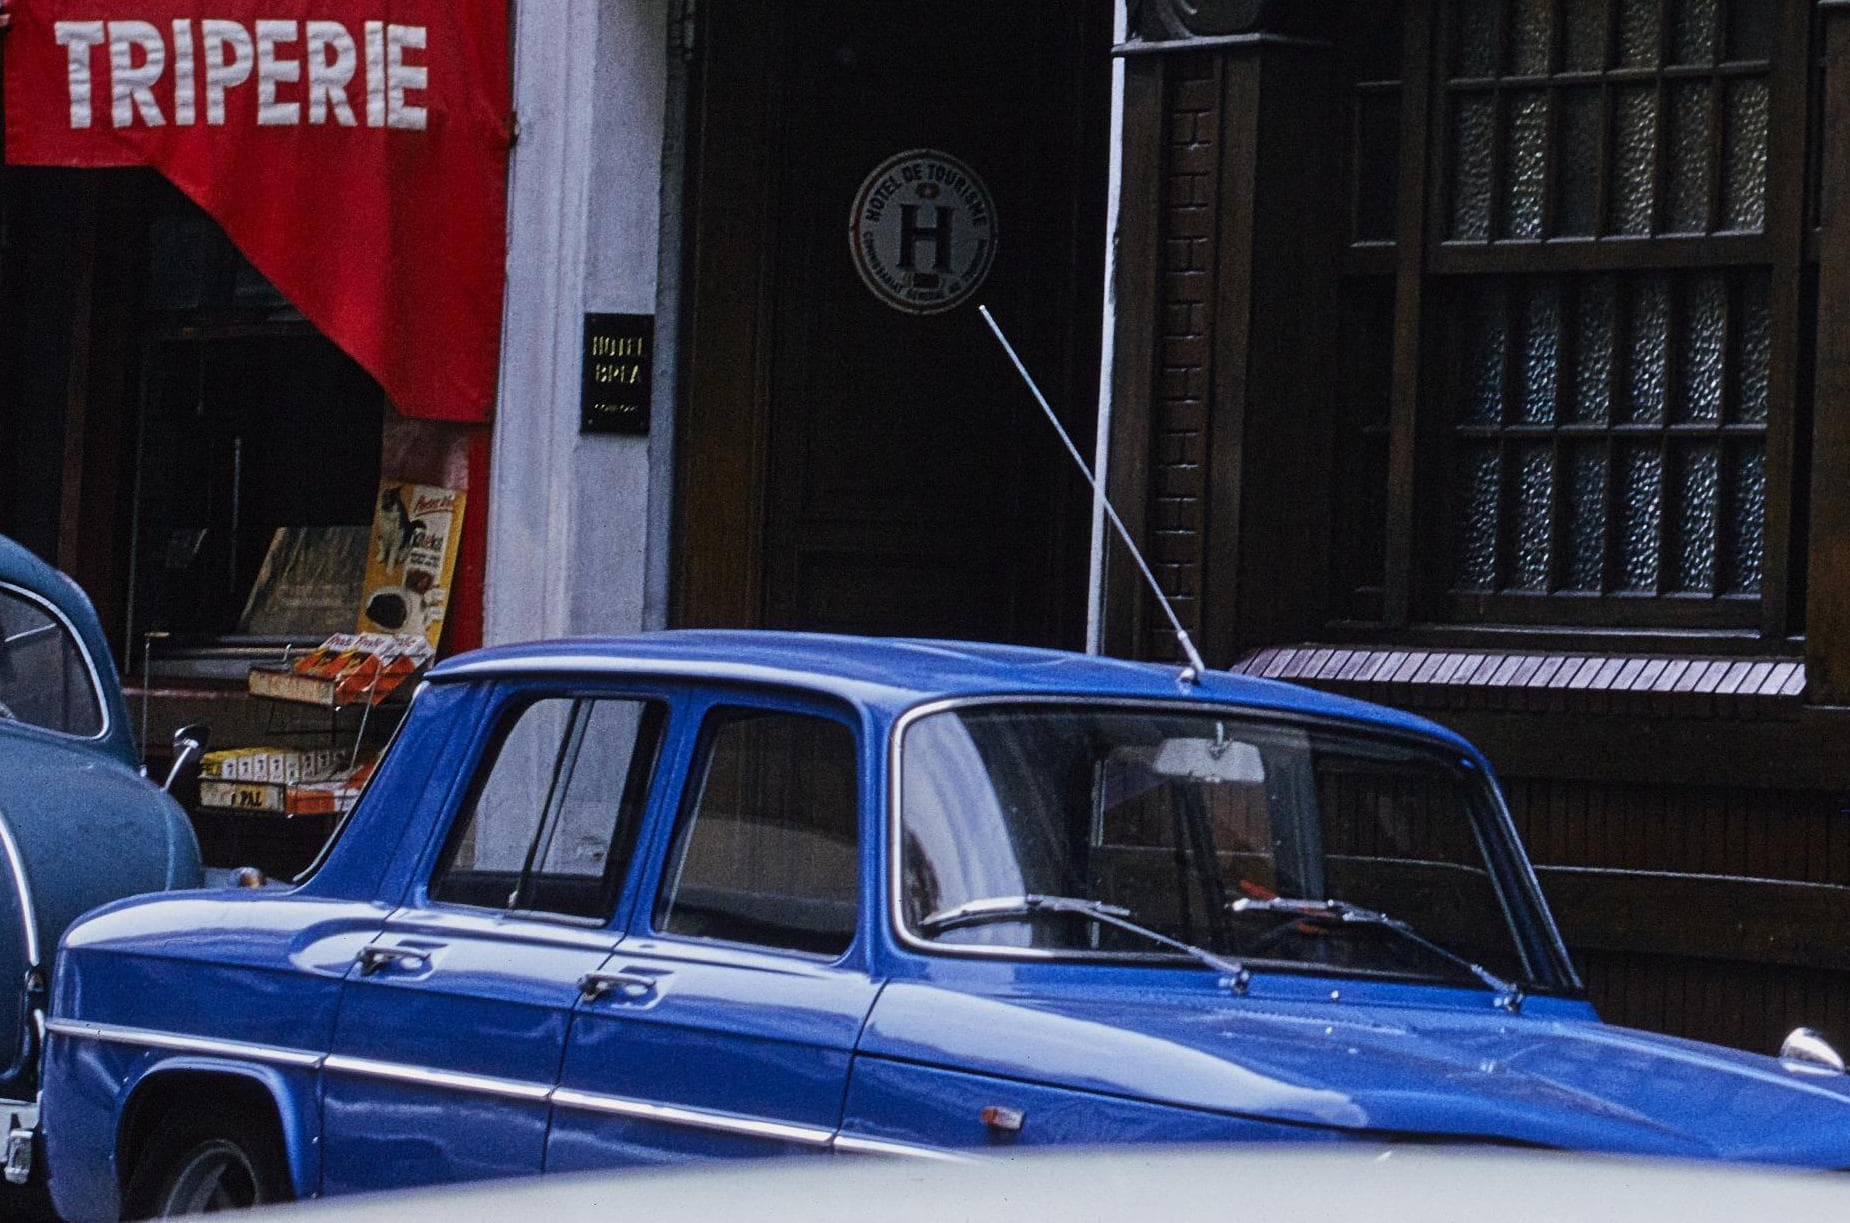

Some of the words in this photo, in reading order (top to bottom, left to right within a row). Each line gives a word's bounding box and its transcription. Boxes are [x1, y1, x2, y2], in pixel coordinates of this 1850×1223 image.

[53, 18, 429, 131] TRIPERIE
[865, 176, 902, 223] HOTEL
[901, 163, 922, 182] DE
[896, 203, 957, 274] H
